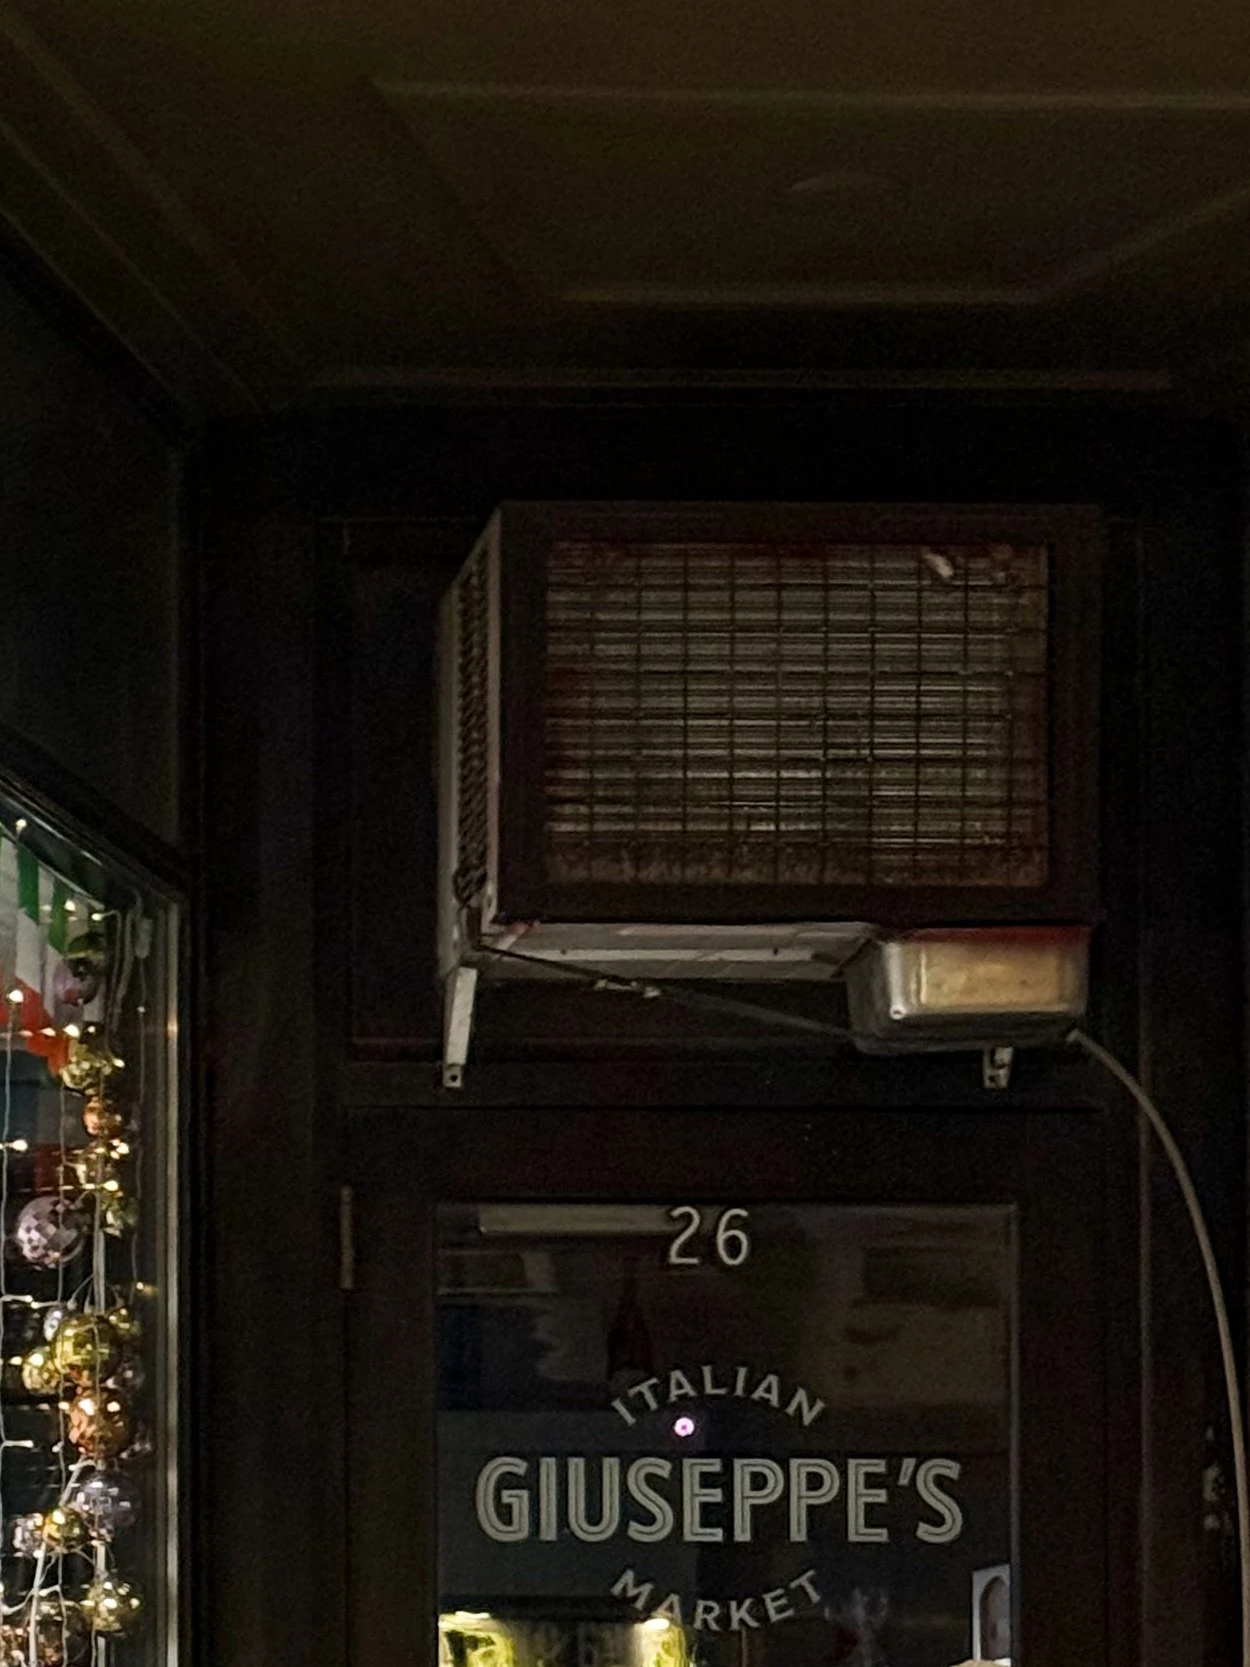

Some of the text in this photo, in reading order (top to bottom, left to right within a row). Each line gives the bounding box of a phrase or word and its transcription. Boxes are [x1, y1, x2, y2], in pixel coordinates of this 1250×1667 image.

[668, 1206, 748, 1266] 26
[611, 1365, 825, 1427] ITALIAN
[475, 1456, 964, 1544] GIUSEPPE'S
[610, 1569, 821, 1631] MARKET
